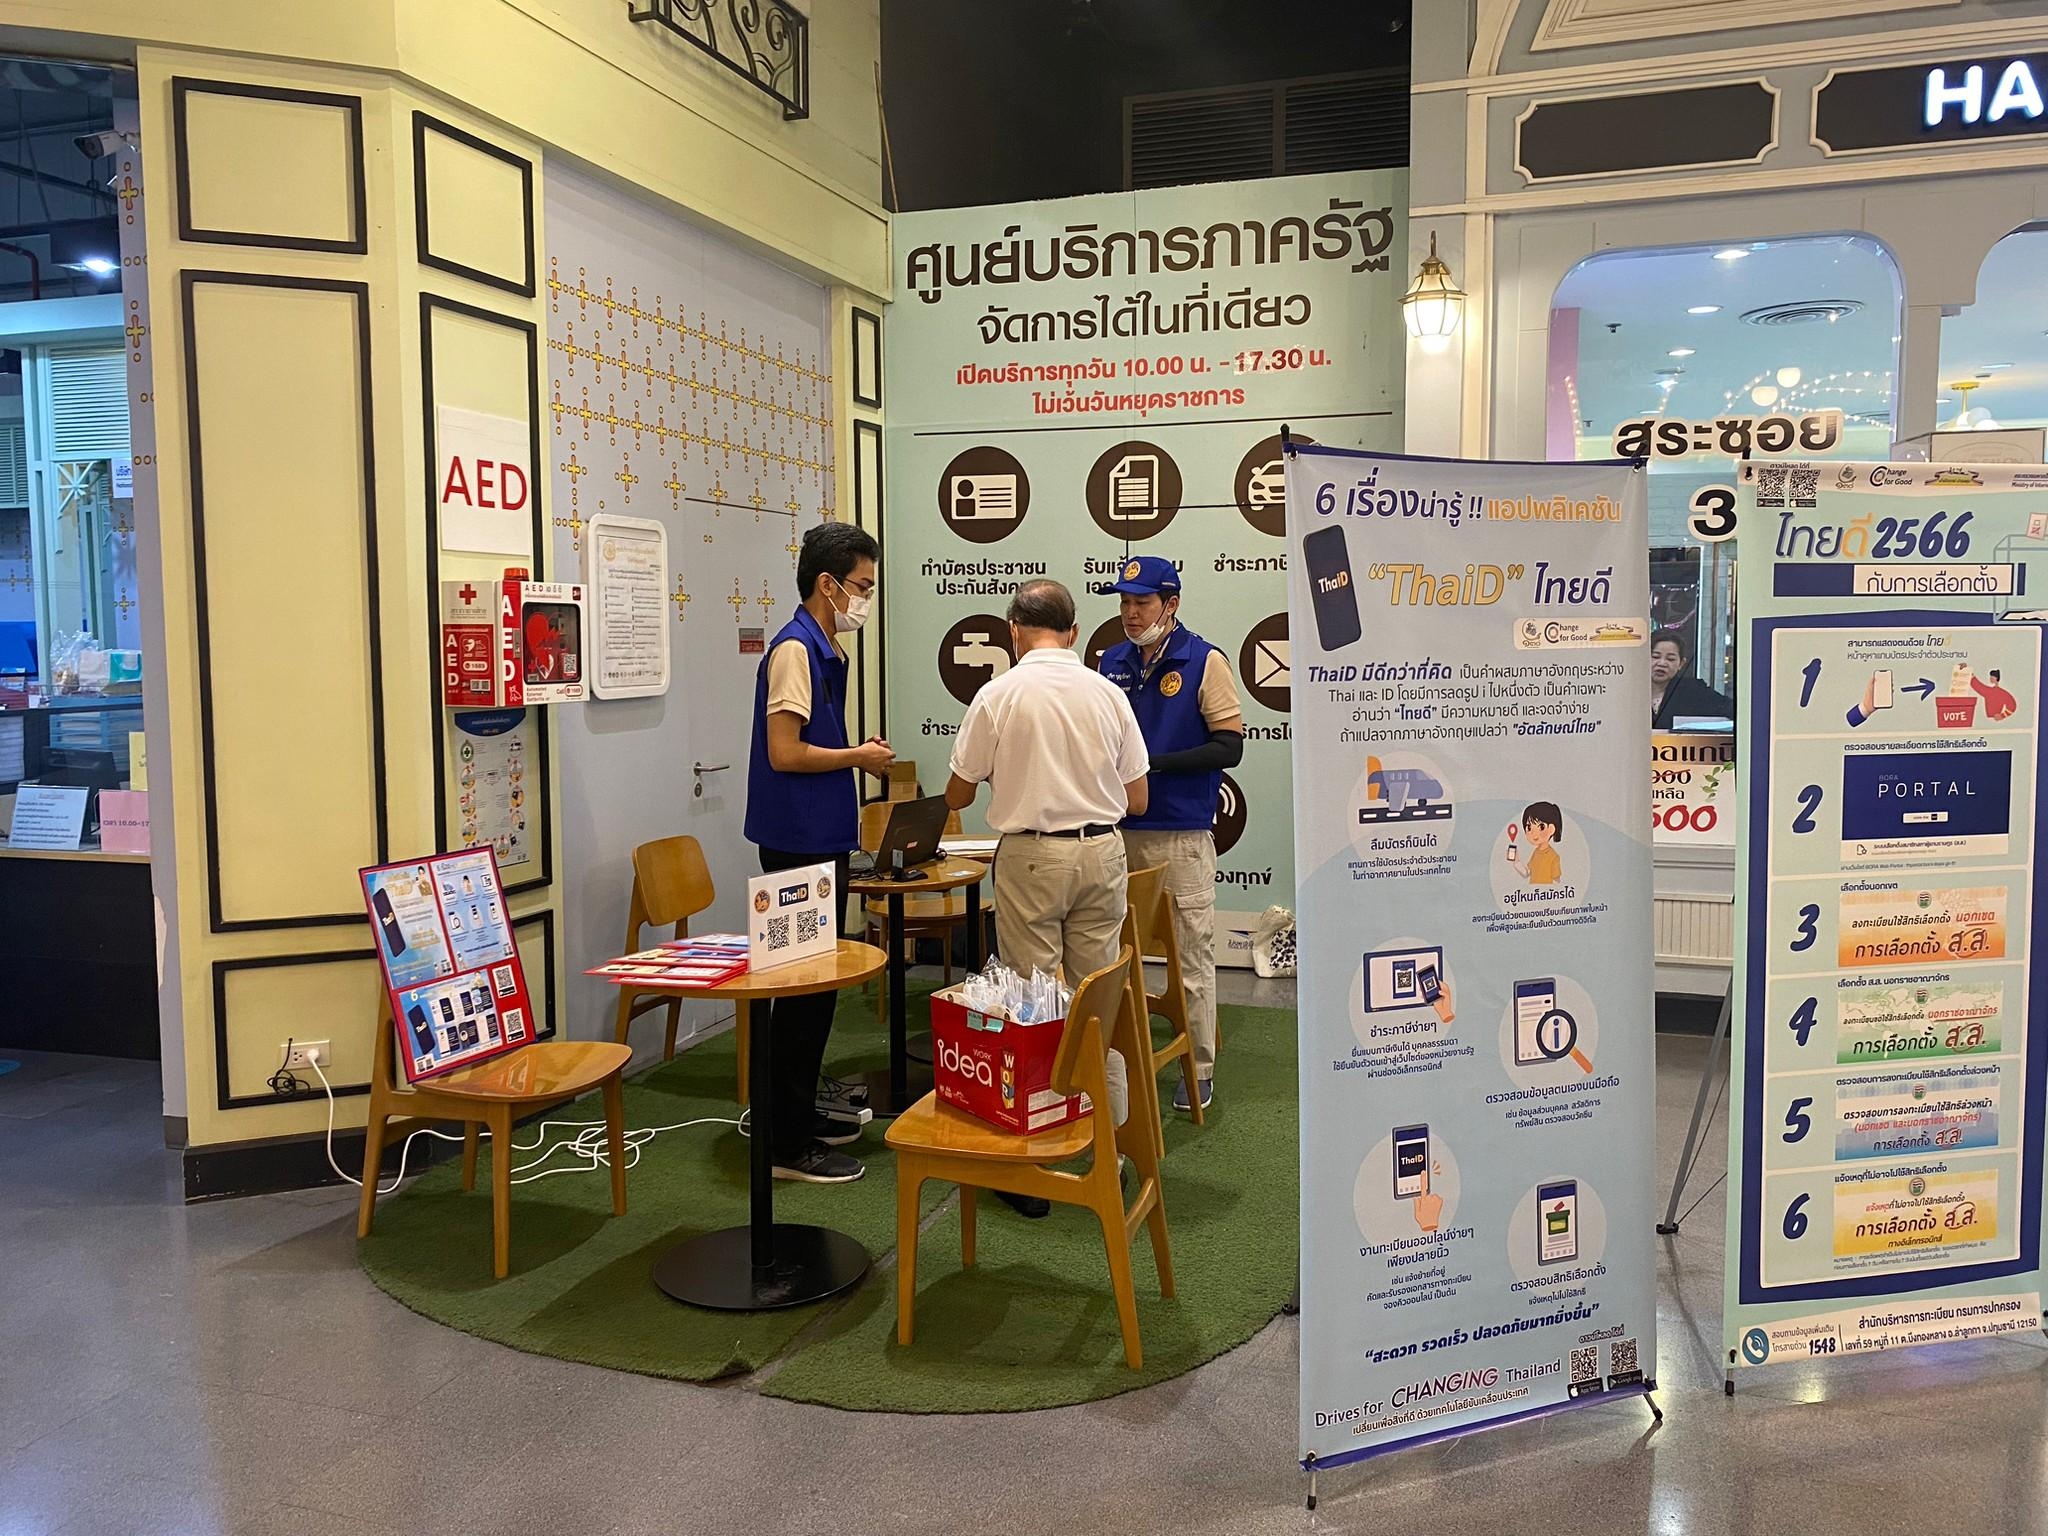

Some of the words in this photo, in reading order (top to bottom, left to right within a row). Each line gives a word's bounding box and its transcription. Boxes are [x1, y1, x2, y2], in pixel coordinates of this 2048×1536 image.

[906, 198, 1394, 304] ศูนย์บริการภาครัฐ
[977, 282, 1312, 345] จัดการได้ในที่เดียว
[956, 356, 1117, 387] เปิดบริการทุกวัน
[1123, 355, 1184, 378] 10.00
[1190, 355, 1212, 374] น.
[1234, 348, 1304, 371] 17.30
[1308, 348, 1332, 367] น.
[1032, 385, 1246, 417] ไม่เว้นวันหยุดราชการ
[1616, 415, 1839, 460] สระซอย
[442, 456, 528, 512] AED
[1315, 482, 1336, 516] 6
[1469, 496, 1483, 520] !!
[1487, 495, 1622, 522] แอปพลิเคชัน
[1775, 511, 1873, 558] ไทยดี
[1872, 510, 1974, 558] 2566
[921, 556, 1047, 577] ทำบัตรประชาชน
[1866, 565, 1998, 593] กับการเลือกตั้ง
[1318, 569, 1349, 593] ThaiD
[1534, 562, 1613, 605] ไทยดี
[1570, 633, 1588, 642] Good
[1308, 666, 1357, 683] ThaiD
[1362, 657, 1453, 681] มีดีกว่าที่คิด
[1460, 661, 1624, 679] เป็นคำผสมภาษาอังกฤษระหว่าง
[1800, 658, 1822, 708] 1
[1328, 689, 1355, 702] Thai
[1359, 690, 1378, 701] และ
[1381, 688, 1394, 701] ID
[1397, 683, 1479, 703] โดยมีการลดรูป
[1489, 680, 1540, 698] ไปหนึ่งตัว
[1543, 681, 1606, 697] เป็นคำเฉพาะ
[1352, 706, 1391, 722] อ่านว่า
[1441, 703, 1519, 719] มีความหมายดี
[1522, 701, 1590, 716] และจดจำง่าย
[1943, 711, 1967, 721] VOTE
[921, 720, 962, 737] ชำระ
[1340, 723, 1508, 743] ถ้าแปลจากภาษาอังกฤษแปลว่า
[1878, 780, 1976, 799] PORTAL
[1792, 785, 1824, 834] 2
[1370, 833, 1437, 851] ลืมบัตรก็บินได้
[1214, 867, 1272, 891] องทุกข์
[1840, 880, 1898, 892] เลือกตั้งนอกเขต
[781, 887, 808, 904] ThaiD
[1503, 885, 1575, 906] อยู่ไหนก็สมัครได้
[1790, 903, 1820, 952] 3
[1955, 910, 1996, 923] นอกเขต
[1854, 931, 1941, 958] การเลือกตั้ง
[1948, 928, 1990, 954] ส.ส.
[1838, 975, 1867, 988] เลือกตั้ง
[1884, 973, 1950, 986] นอกราชอาณาจักร
[1370, 1021, 1437, 1038] ชำระภาษีง่ายๆ
[1789, 997, 1818, 1047] 4
[1853, 1026, 1938, 1054] การเลือกตั้ง
[1945, 1023, 1986, 1048] ส.ส.
[937, 1039, 993, 1088] idea
[973, 1048, 993, 1061] WORK
[1485, 1075, 1620, 1104] ตรวจสอบข้อมูลตนเองบนมือถือ
[1782, 1097, 1812, 1143] 5
[1873, 1130, 1930, 1151] การเลือกตั้ง
[1401, 1153, 1424, 1167] ThaiD
[1782, 1192, 1811, 1240] 6
[1855, 1208, 1937, 1237] การเลือกตั้ง
[1944, 1207, 1978, 1228] ส.ส.
[1359, 1227, 1474, 1257] งานทะเบียนออนไลน์ง่ายๆ
[1387, 1243, 1450, 1268] เพียงปลายนิ้ว
[1510, 1261, 1607, 1292] ตรวจสอบสิทธิเลือกตั้ง
[1858, 1306, 1954, 1330] สำนักบริหารการทะเบียน
[1955, 1300, 2022, 1318] กรมการปกครอง
[1421, 1330, 1470, 1353] รวดเร็ว
[1808, 1336, 1836, 1356] 1548
[1845, 1336, 1862, 1351] เลขที่
[1863, 1339, 1873, 1349] 59
[1890, 1335, 1899, 1346] 11
[2016, 1317, 2037, 1329] 12150
[1314, 1405, 1361, 1428] Drives
[1363, 1399, 1384, 1415] for
[1391, 1367, 1499, 1409] CHANGING
[1506, 1359, 1561, 1383] Thailand
